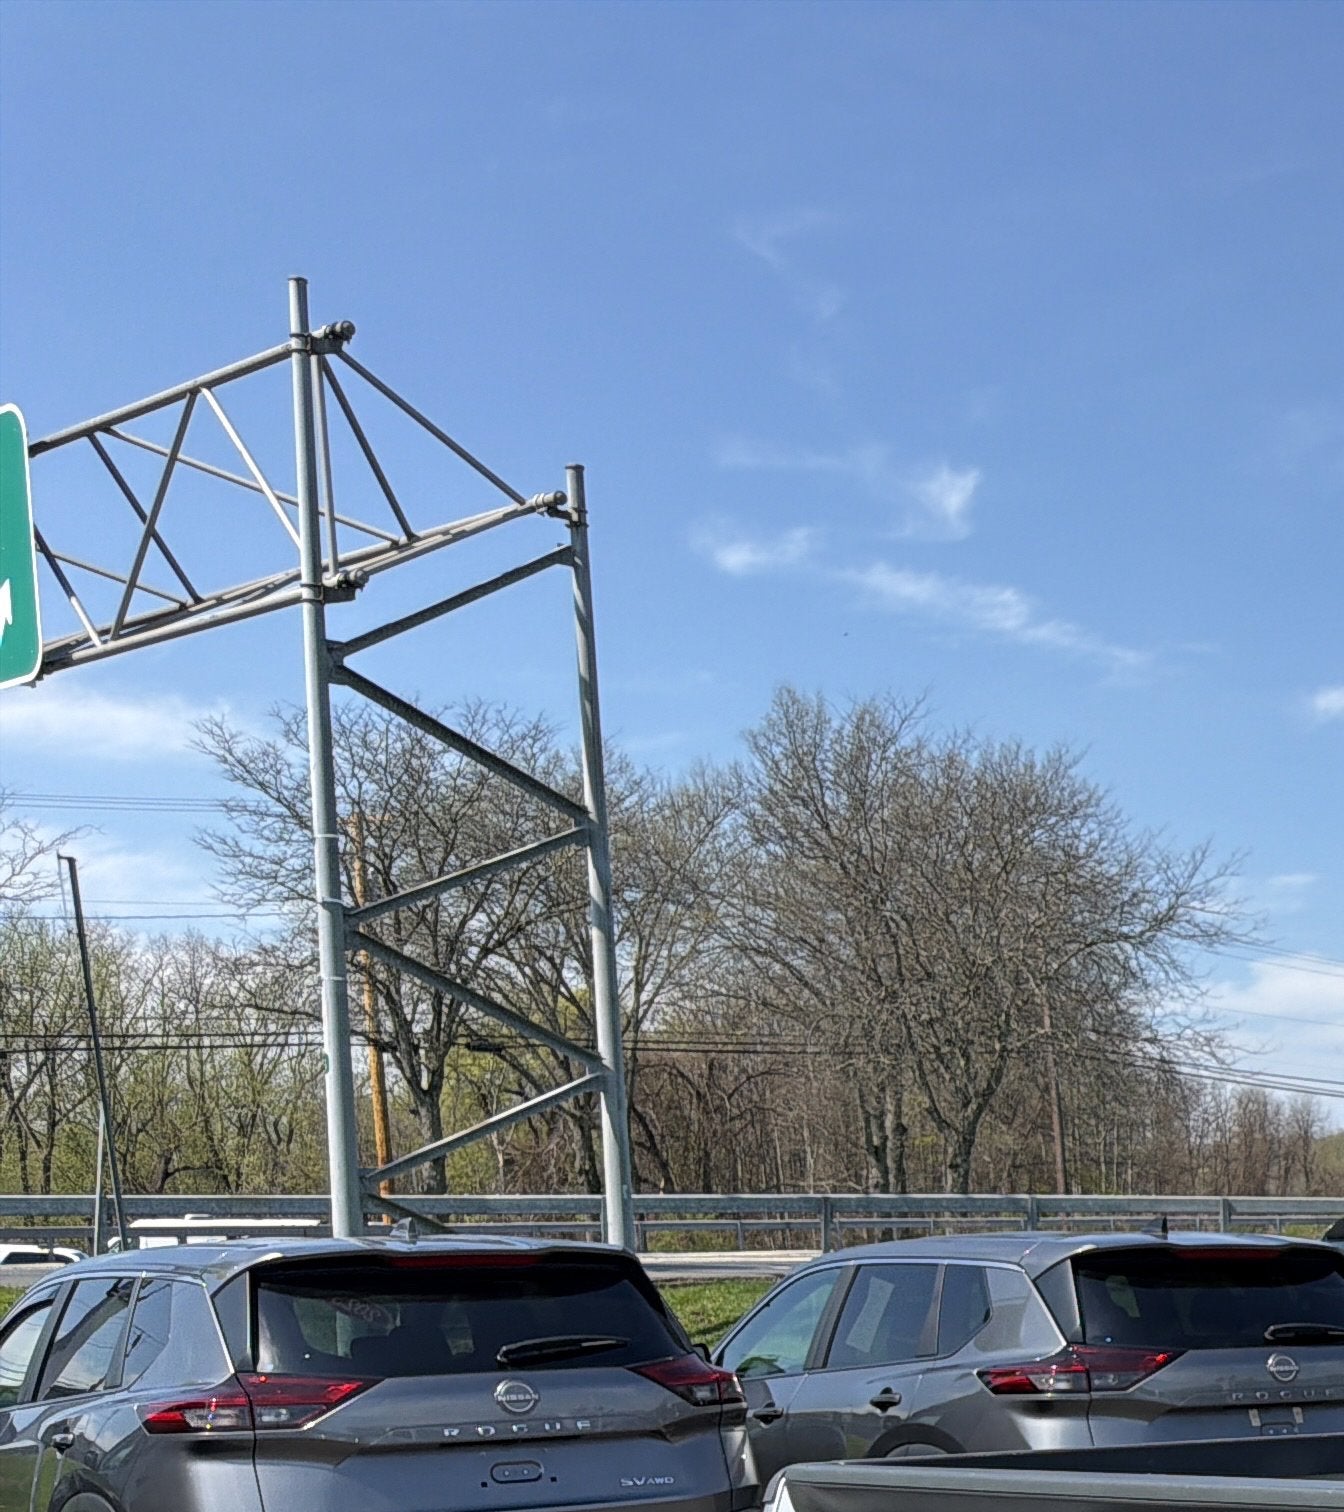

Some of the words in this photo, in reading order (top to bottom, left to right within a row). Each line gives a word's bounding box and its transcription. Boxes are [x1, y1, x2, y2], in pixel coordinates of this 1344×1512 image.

[497, 1393, 539, 1402] NISSAN
[1232, 1388, 1335, 1400] ROGUE
[443, 1420, 592, 1437] ROGUE
[620, 1476, 646, 1487] SV
[646, 1476, 675, 1485] AWD
